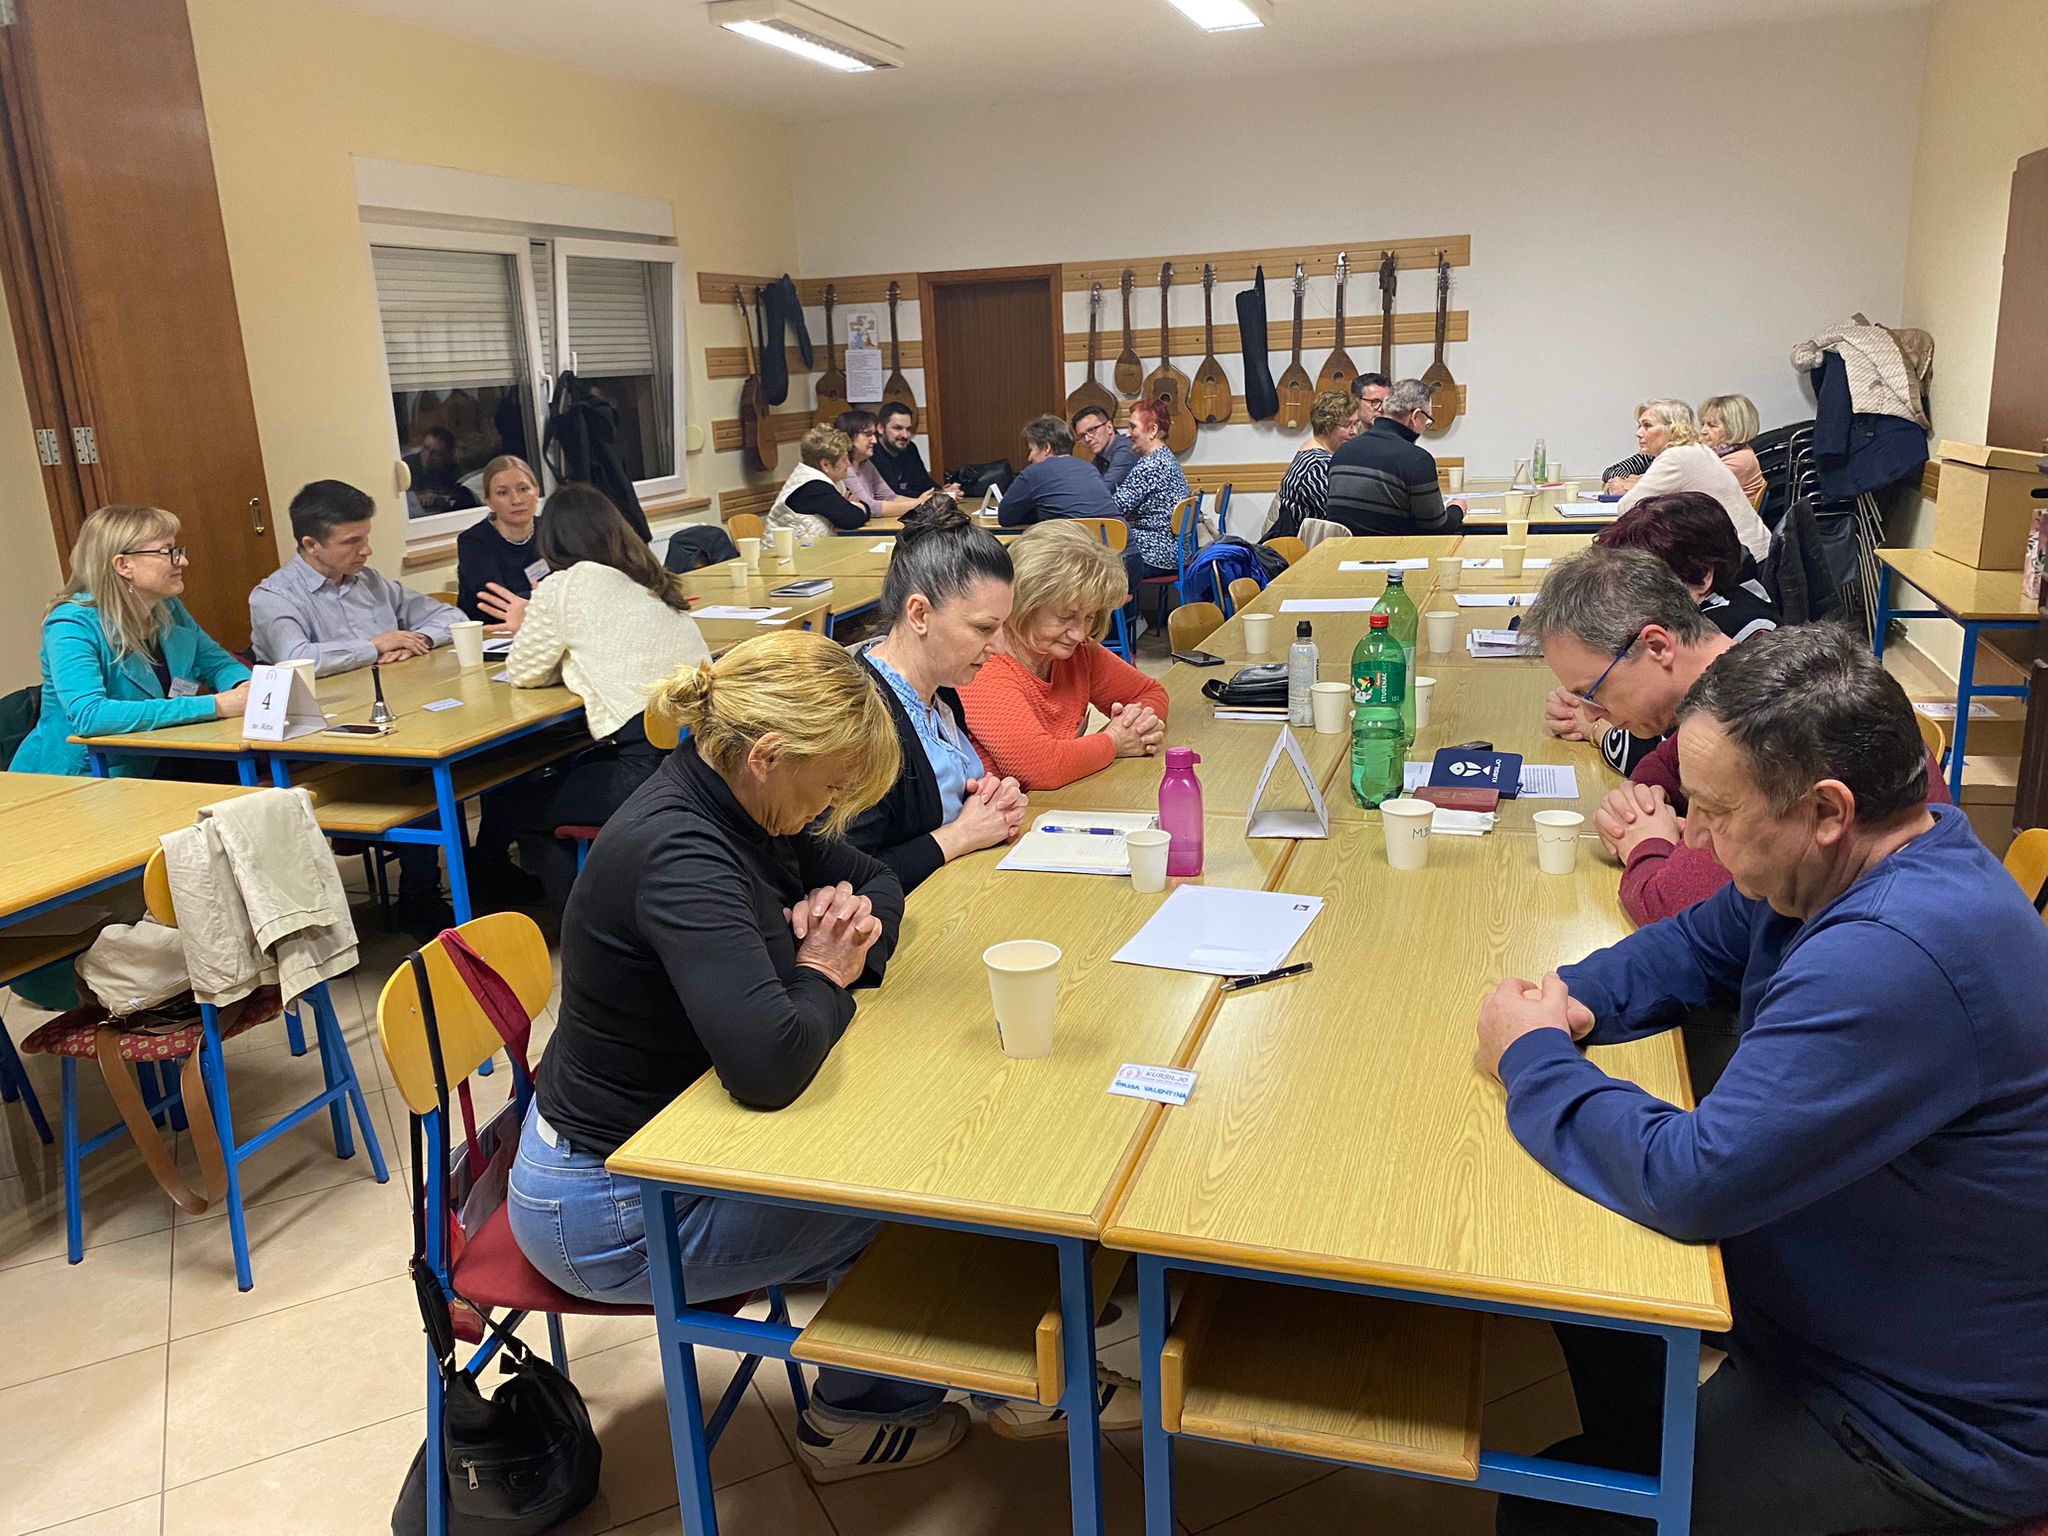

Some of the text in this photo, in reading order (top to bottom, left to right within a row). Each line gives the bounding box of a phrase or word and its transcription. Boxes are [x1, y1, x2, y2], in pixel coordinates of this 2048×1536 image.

[261, 692, 272, 710] 4
[1491, 758, 1502, 784] KURSILJO
[1145, 1071, 1189, 1083] KURSILJO
[1144, 1086, 1187, 1099] VALENTINA
